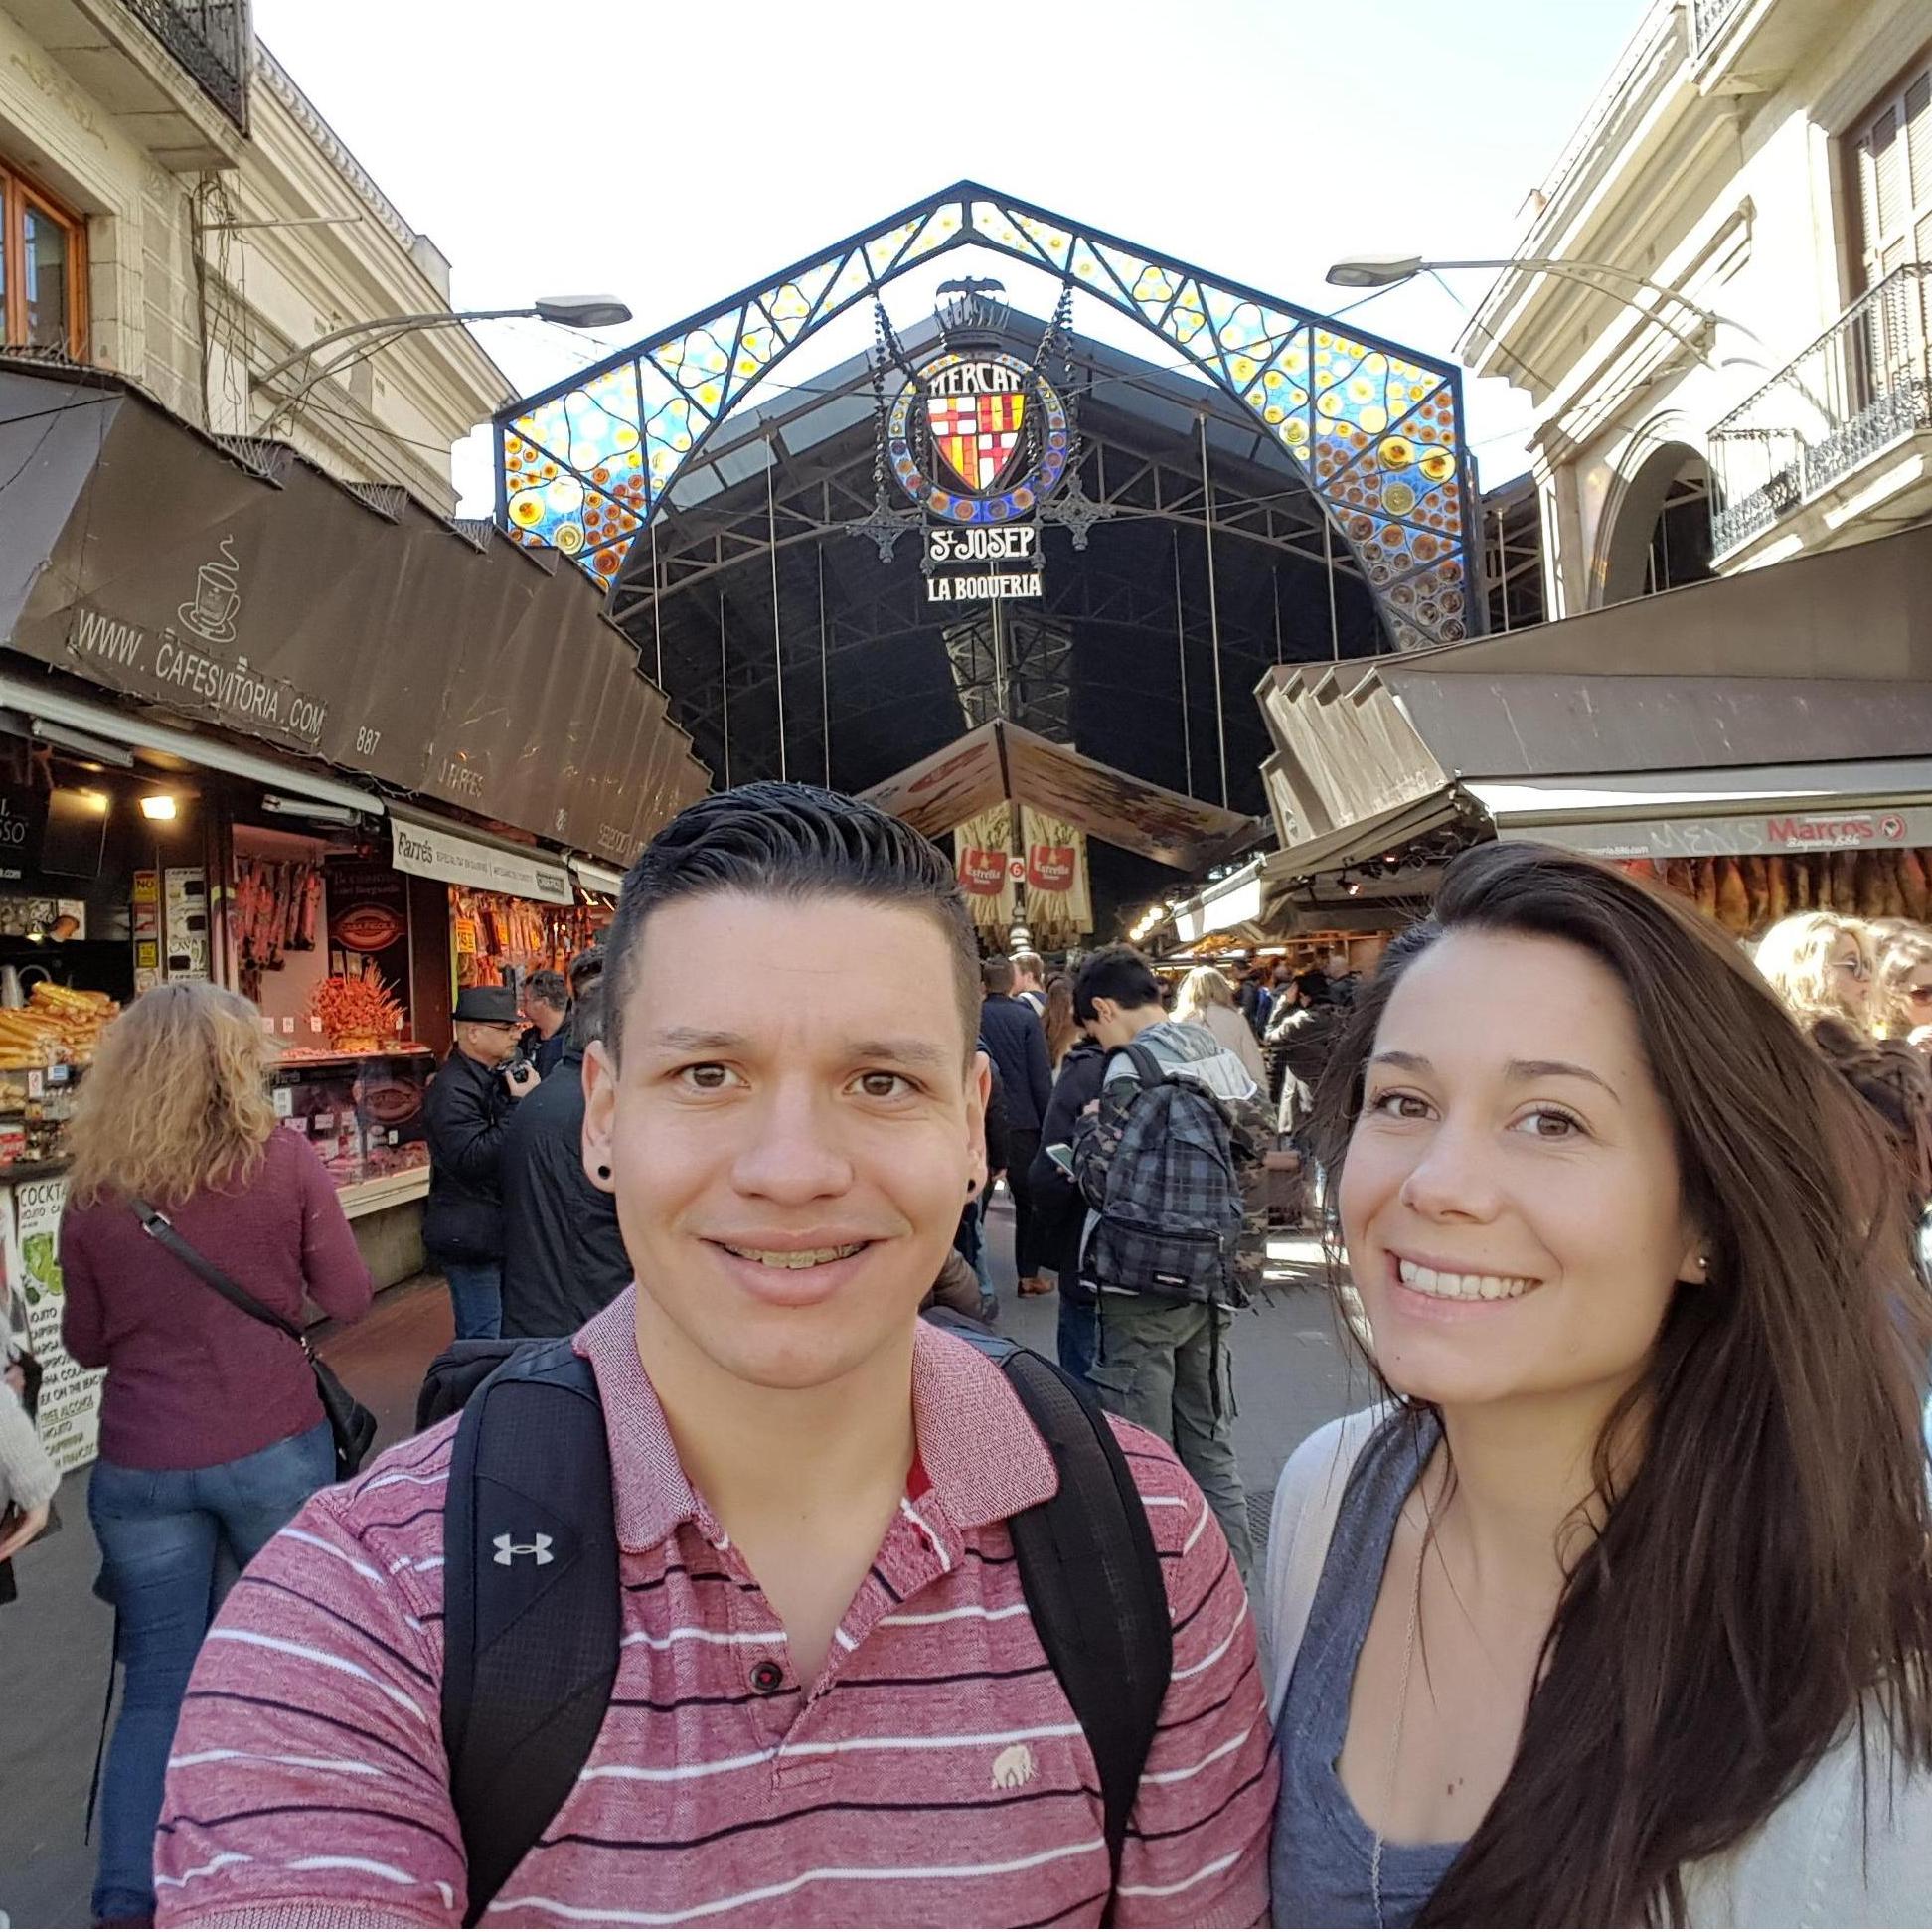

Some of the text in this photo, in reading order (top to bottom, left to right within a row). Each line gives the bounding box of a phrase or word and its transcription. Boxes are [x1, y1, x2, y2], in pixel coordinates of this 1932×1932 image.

[927, 361, 1022, 397] MERCAT
[954, 526, 1035, 560] JOSEP
[927, 573, 1042, 602] LA BOQUERIA
[356, 726, 381, 755] 887
[1766, 816, 1874, 843] Marcos
[1012, 863, 1023, 876] 6
